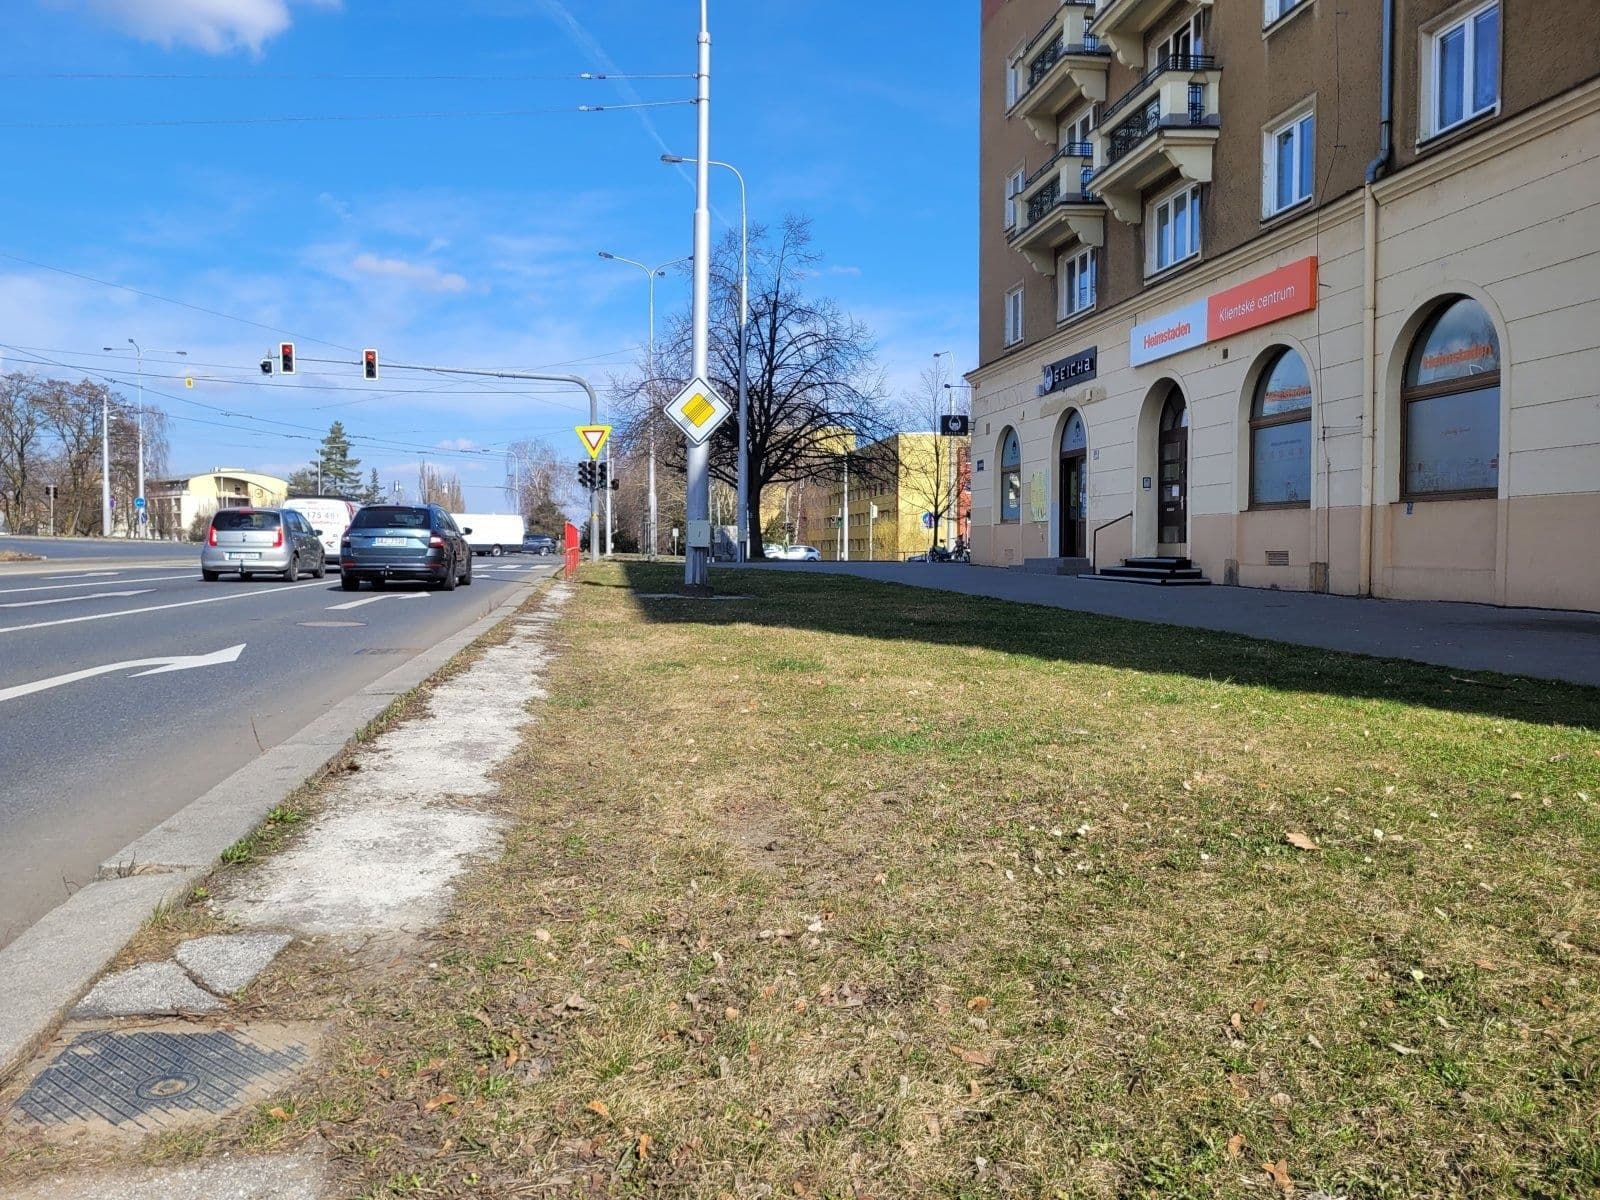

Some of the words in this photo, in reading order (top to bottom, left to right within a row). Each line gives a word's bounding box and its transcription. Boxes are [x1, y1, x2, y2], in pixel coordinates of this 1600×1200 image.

[1219, 297, 1255, 323] Klientské
[1257, 285, 1295, 310] centrum
[1143, 322, 1191, 350] Heimstaden
